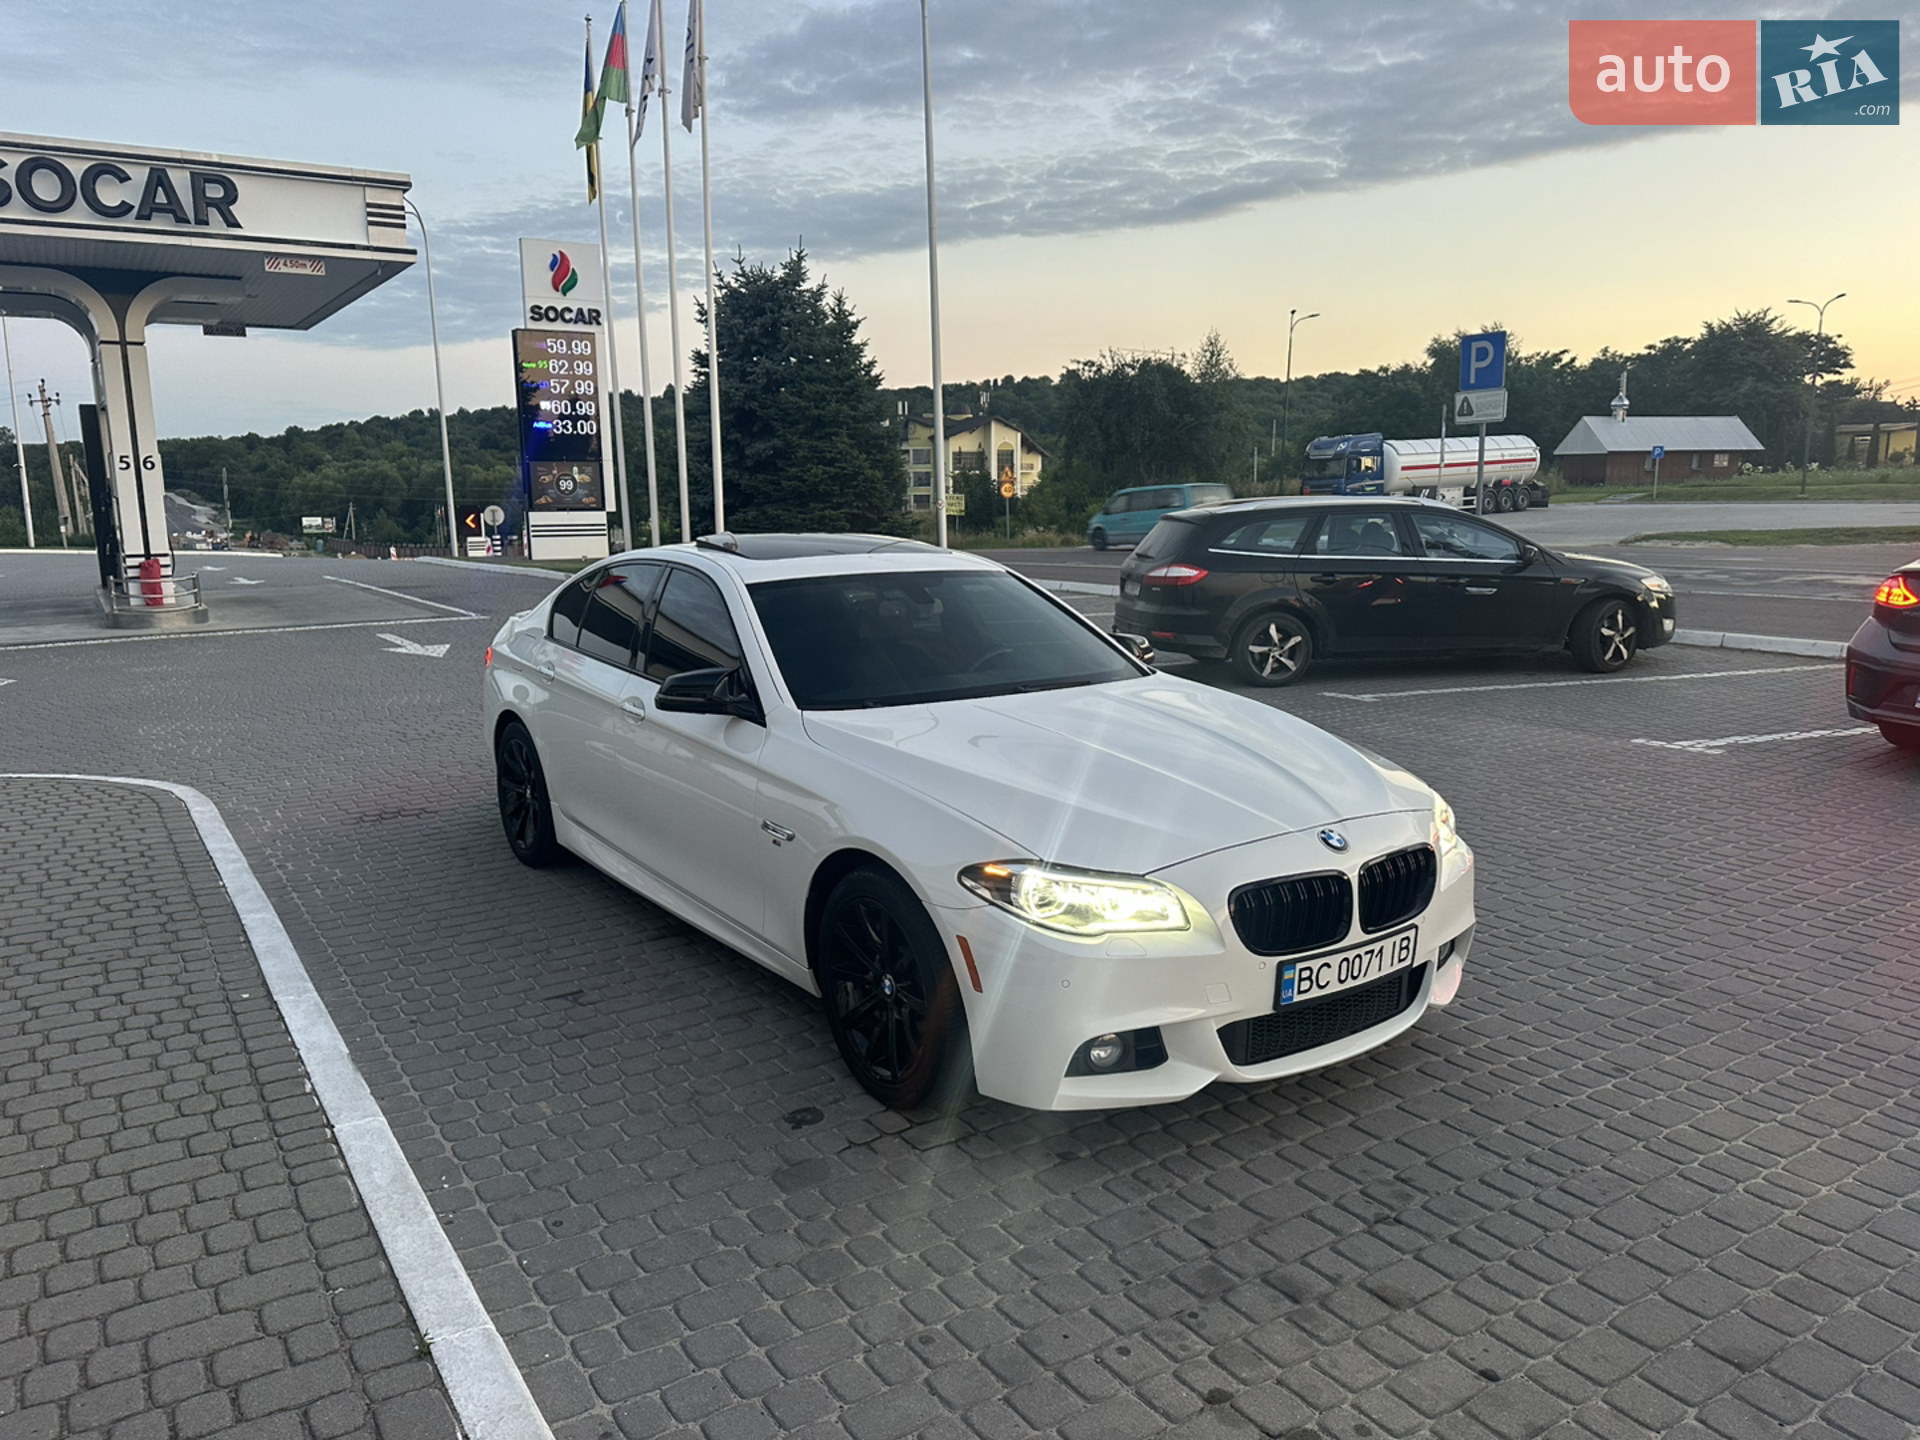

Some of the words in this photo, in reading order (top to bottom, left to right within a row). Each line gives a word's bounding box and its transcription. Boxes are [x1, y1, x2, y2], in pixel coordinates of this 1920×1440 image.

[0, 155, 243, 229] OCAR
[530, 304, 602, 326] SOCAR
[546, 338, 591, 355] 59.99
[549, 359, 593, 375] 62.99
[1469, 340, 1494, 384] P
[550, 379, 594, 395] 57.99
[551, 399, 595, 415] 60.99
[552, 419, 596, 435] 33.00
[118, 455, 131, 470] 5
[142, 455, 156, 471] 6
[559, 479, 574, 490] 99
[1296, 962, 1331, 996] BC
[1337, 944, 1385, 985] 0071
[1389, 935, 1411, 967] IB
[1281, 988, 1293, 999] UA
